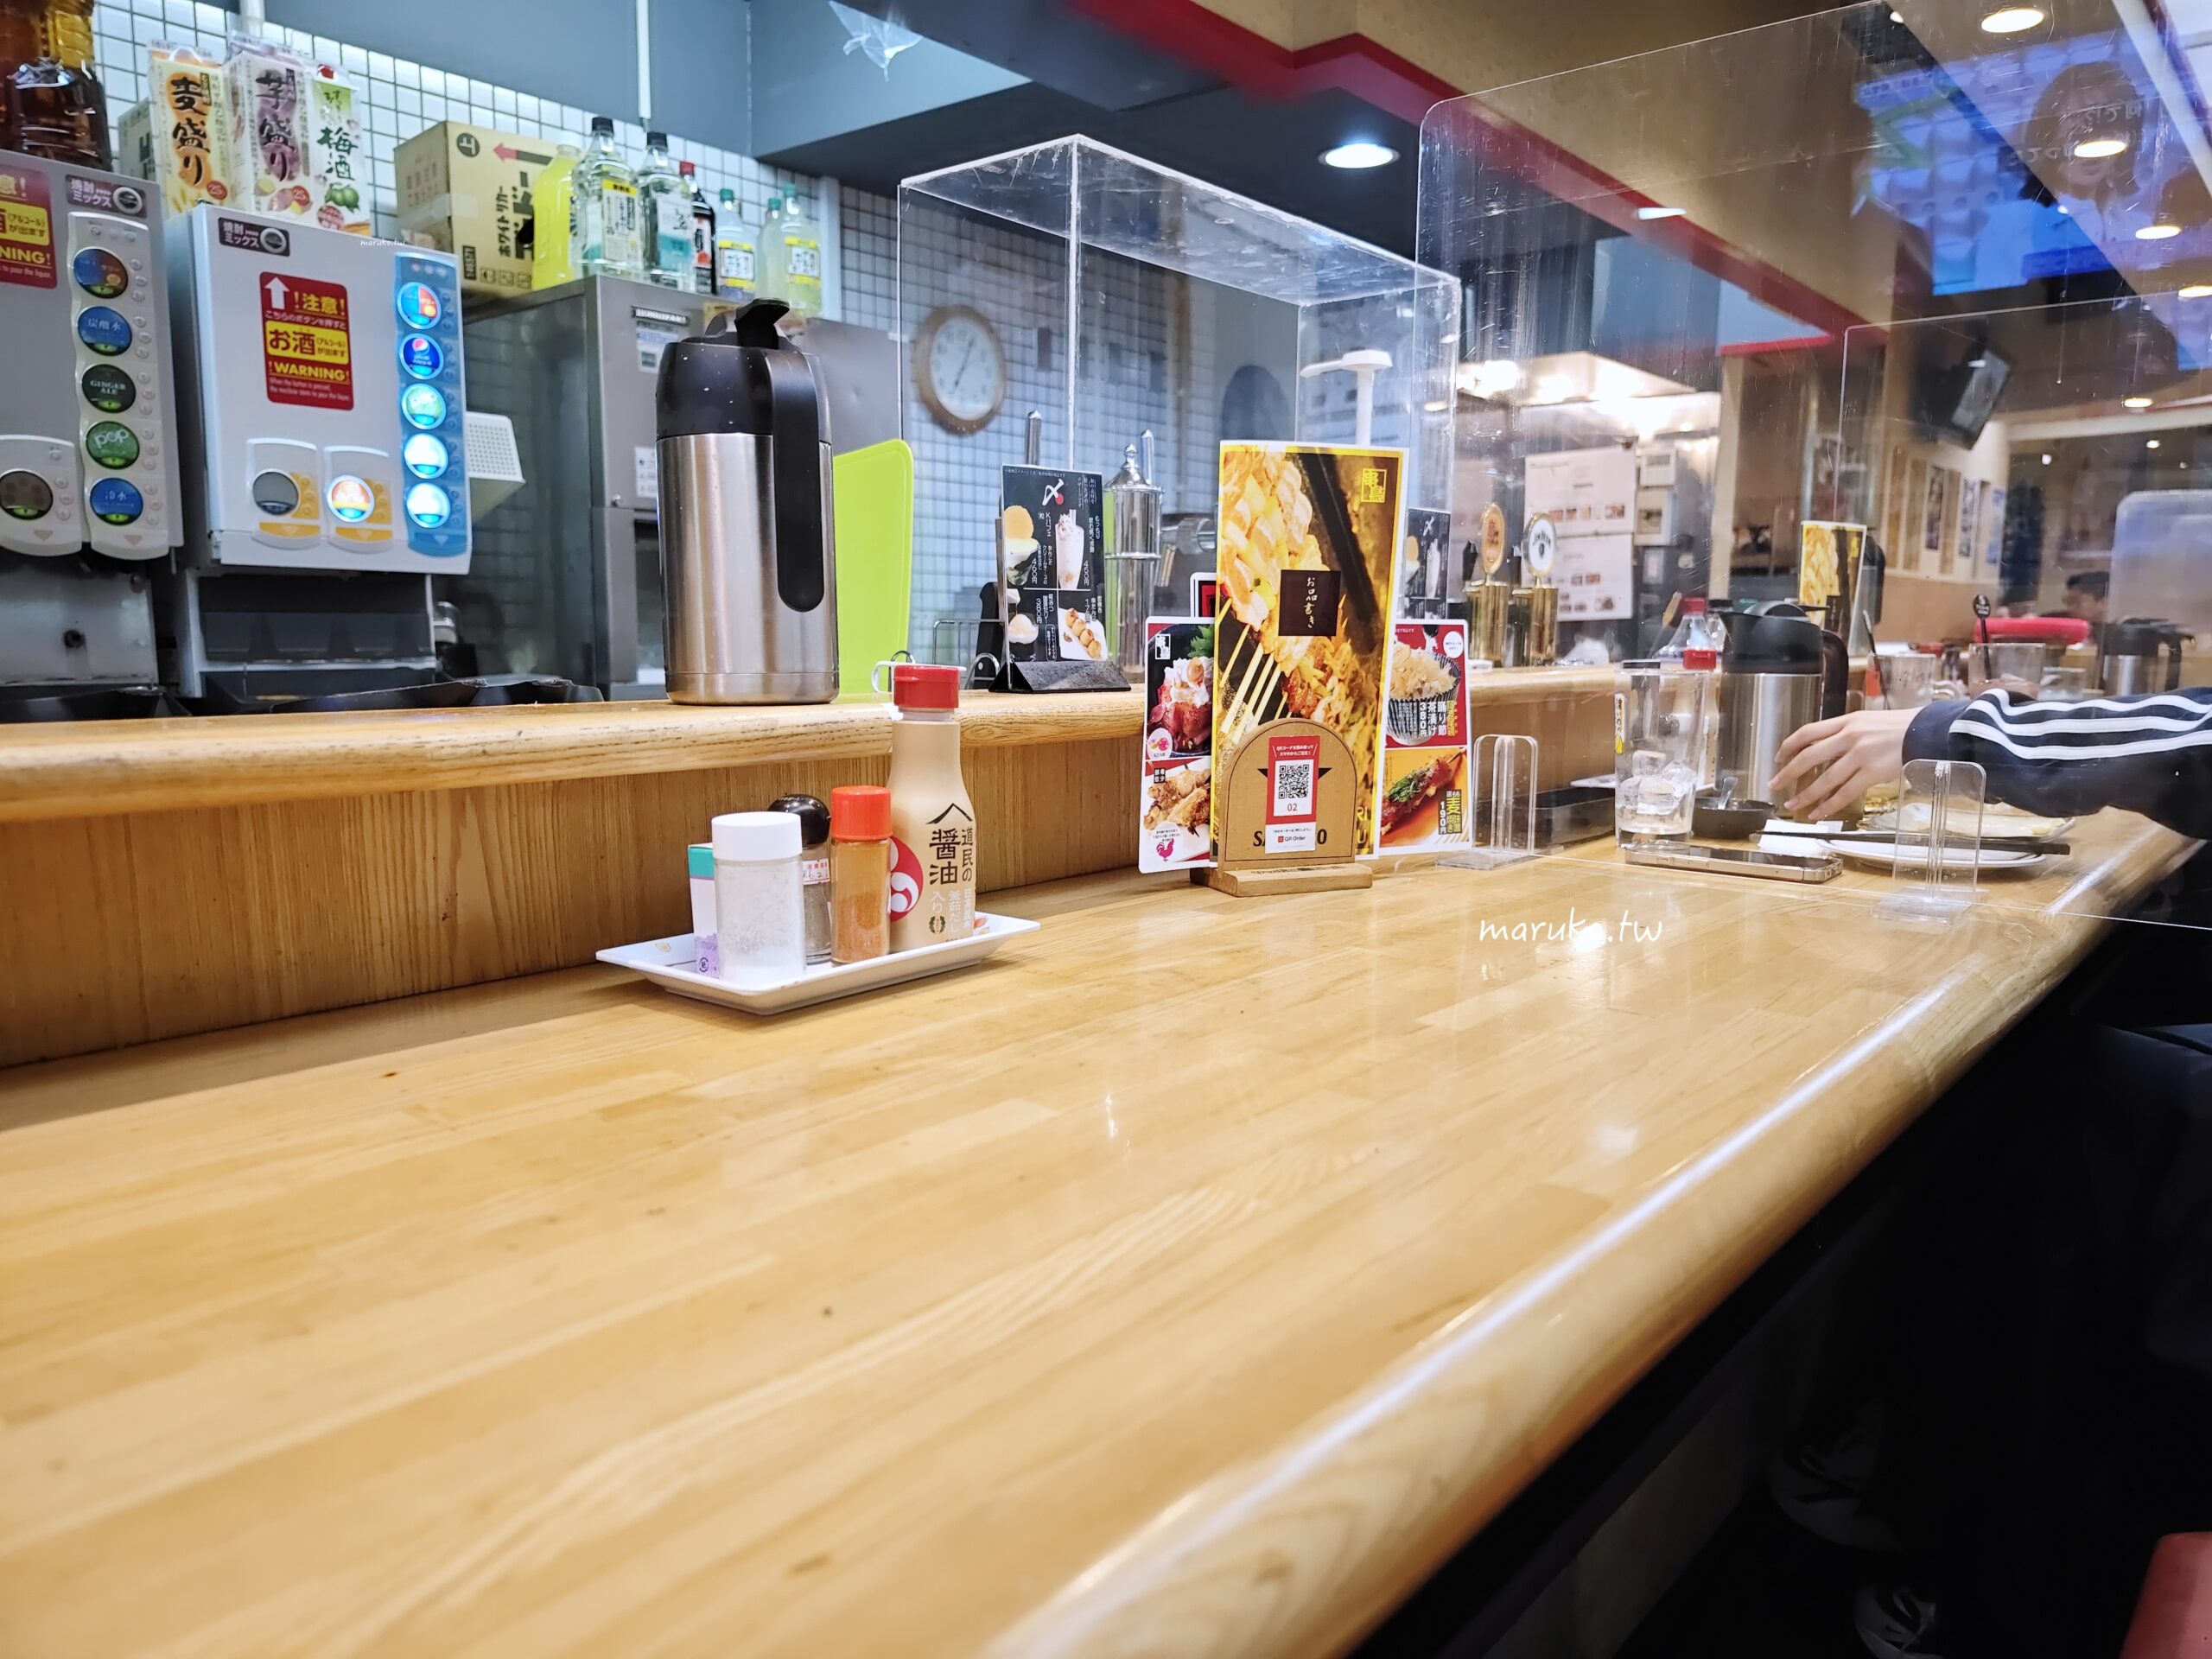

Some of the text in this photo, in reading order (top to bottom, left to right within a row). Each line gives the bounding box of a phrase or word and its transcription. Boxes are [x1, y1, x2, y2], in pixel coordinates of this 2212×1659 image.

[169, 76, 212, 185] 麦盛り
[256, 74, 297, 182] 芋盛り
[316, 127, 359, 181] 梅酒
[73, 190, 112, 208] ミックス
[225, 233, 259, 248] ミックス
[270, 329, 315, 355] お酒
[90, 380, 126, 390] GINGER
[99, 386, 118, 395] ALE
[94, 429, 130, 449] pop
[1303, 577, 1319, 629] お品書き
[961, 826, 973, 882] 道民の
[930, 891, 945, 913] 入り
